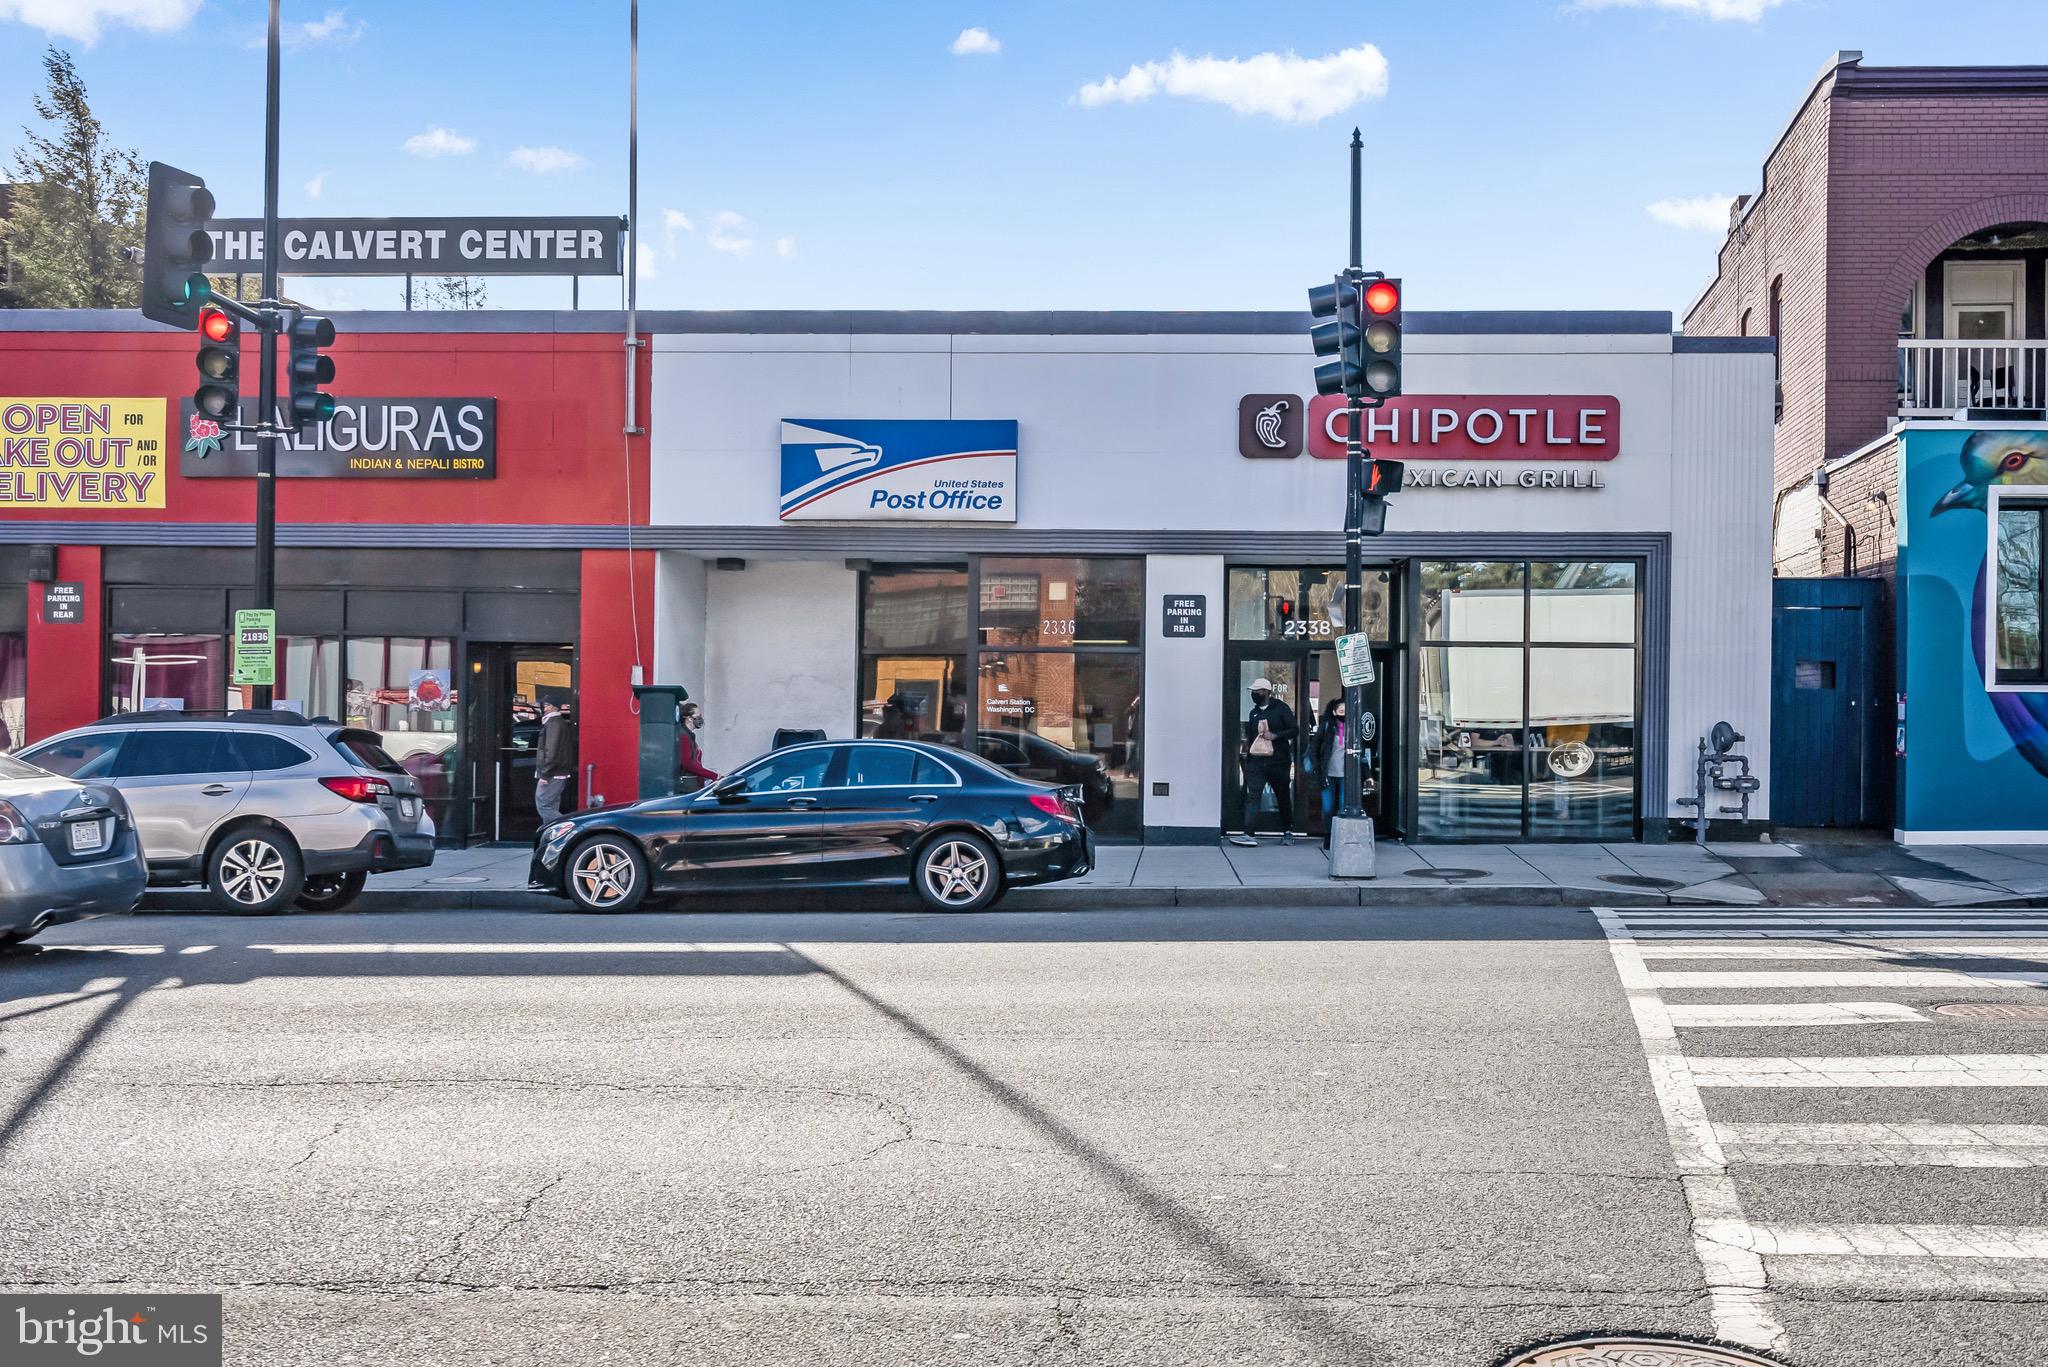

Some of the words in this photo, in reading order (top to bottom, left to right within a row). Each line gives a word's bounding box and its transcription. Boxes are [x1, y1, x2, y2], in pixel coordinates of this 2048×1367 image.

[205, 230, 264, 260] THE
[284, 229, 446, 260] CALVERT
[459, 229, 603, 260] CENTER
[2, 404, 110, 434] OPEN
[124, 414, 144, 425] FOR
[1325, 408, 1606, 444] CHIPOTLE
[235, 405, 484, 451] LALIGURAS
[0, 438, 50, 467] KE
[54, 437, 132, 468] OUT
[137, 440, 157, 451] AND
[350, 459, 391, 469] INDIAN
[395, 459, 403, 469] &
[407, 459, 450, 469] NEPALI
[453, 459, 484, 469] BISTRO
[934, 480, 968, 488] United
[971, 480, 1004, 488] States
[1403, 469, 1502, 488] XICAN
[1519, 470, 1605, 489] GRILL
[0, 472, 155, 502] ELIVERY
[870, 489, 926, 509] Post
[929, 490, 1002, 509] Office
[1167, 608, 1202, 616] PARKING
[1043, 620, 1075, 635] 2336
[1284, 620, 1331, 635] 2338
[242, 632, 268, 641] 21836
[1272, 683, 1288, 693] FOR
